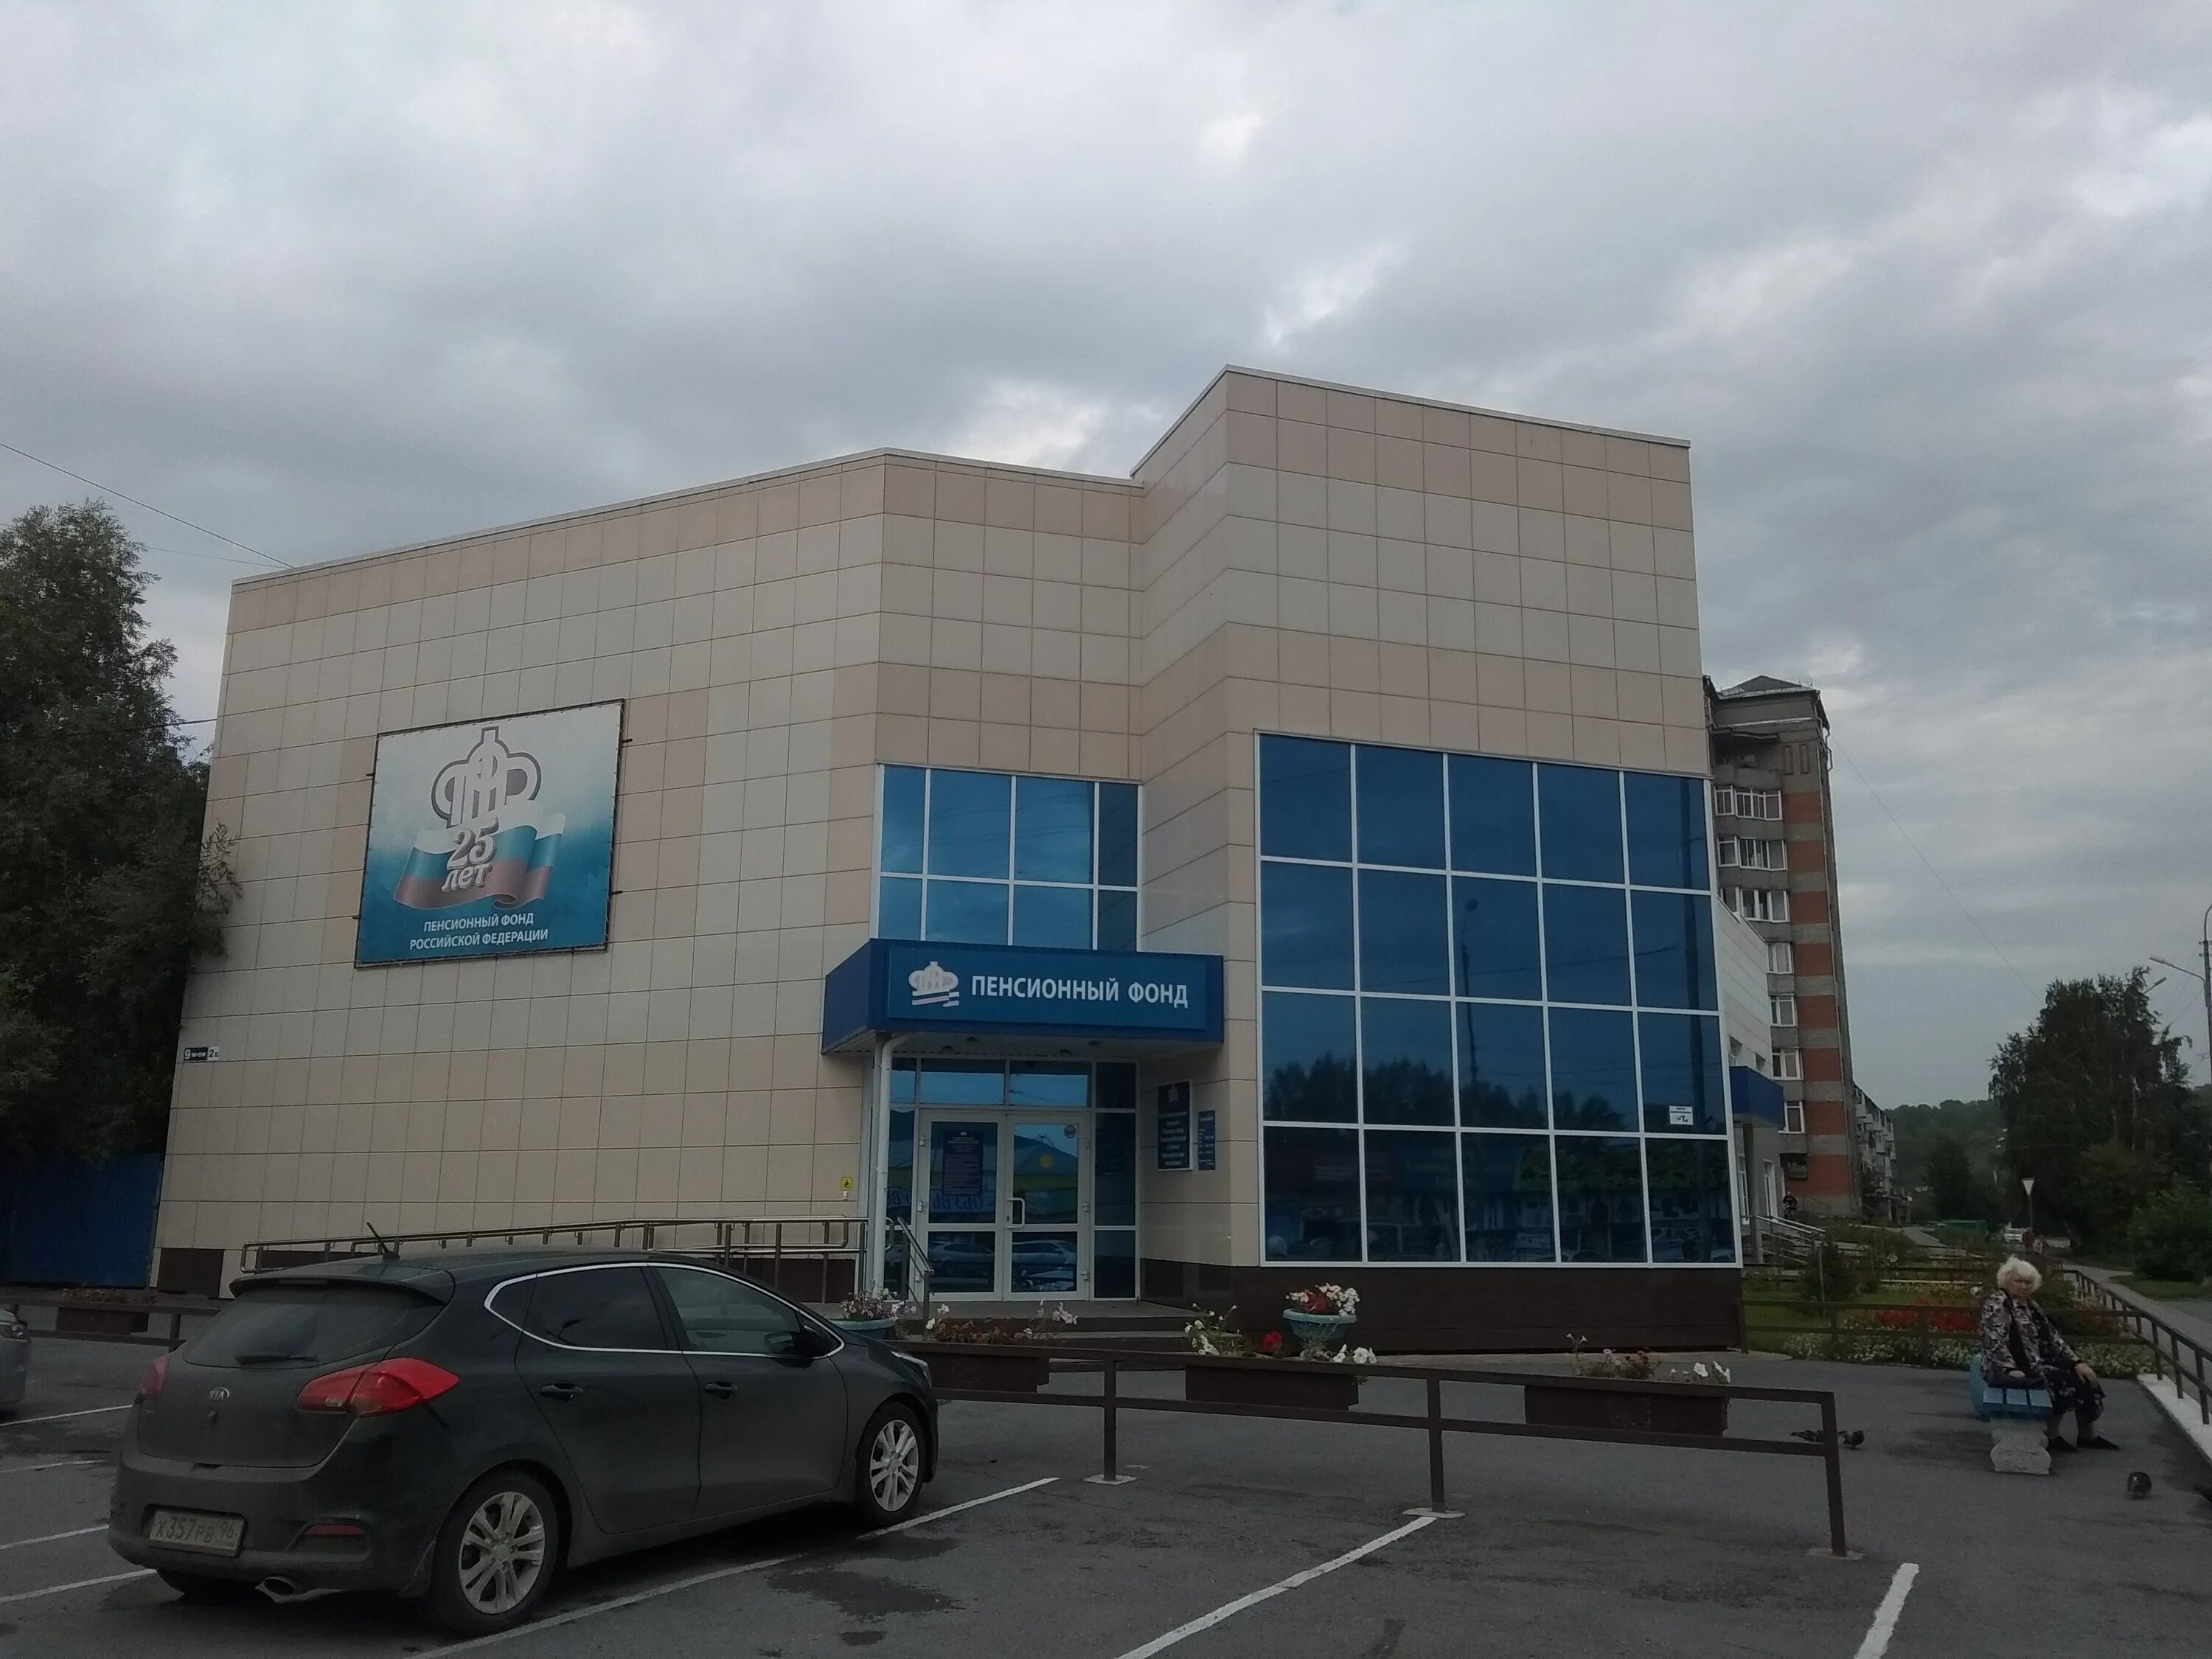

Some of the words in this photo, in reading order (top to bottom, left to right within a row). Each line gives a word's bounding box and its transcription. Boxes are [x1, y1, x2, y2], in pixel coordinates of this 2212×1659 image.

[447, 817, 499, 870] 25
[442, 863, 493, 892] лет
[424, 914, 499, 932] ПЕНСИОННЫЙ
[501, 912, 535, 927] ФОНД
[410, 933, 480, 950] РОССИЙСКОЙ
[482, 928, 549, 945] ФЕДЕРАЦИИ
[972, 975, 1119, 1001] ПЕНСИОННЫЙ
[1128, 982, 1188, 1009] ФОНД
